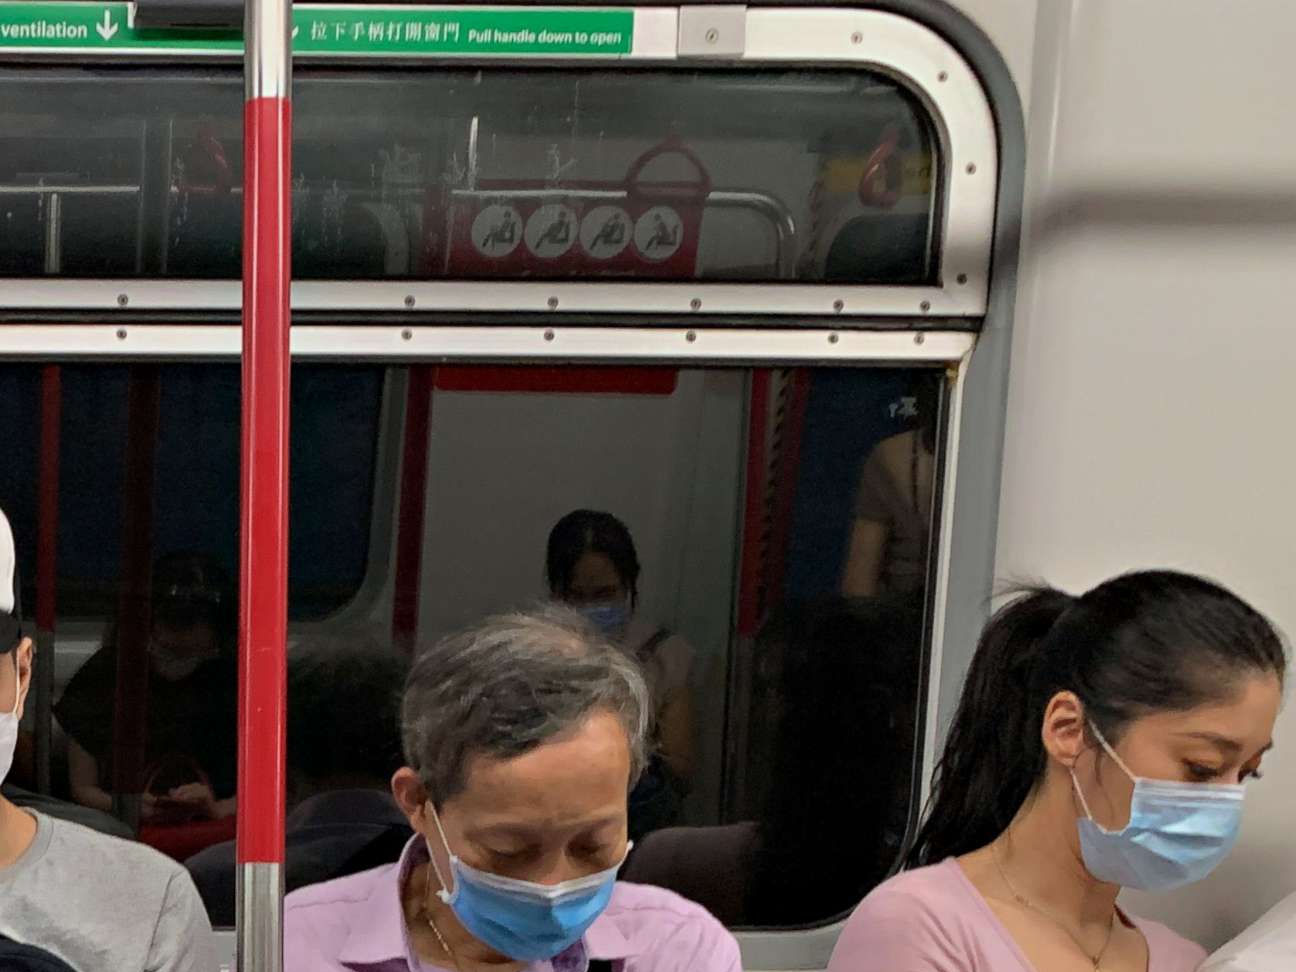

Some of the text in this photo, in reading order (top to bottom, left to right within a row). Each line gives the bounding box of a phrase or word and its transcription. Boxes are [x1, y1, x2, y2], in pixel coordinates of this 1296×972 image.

[1, 21, 87, 38] ventilation
[468, 29, 621, 46] Pull handle down to open
